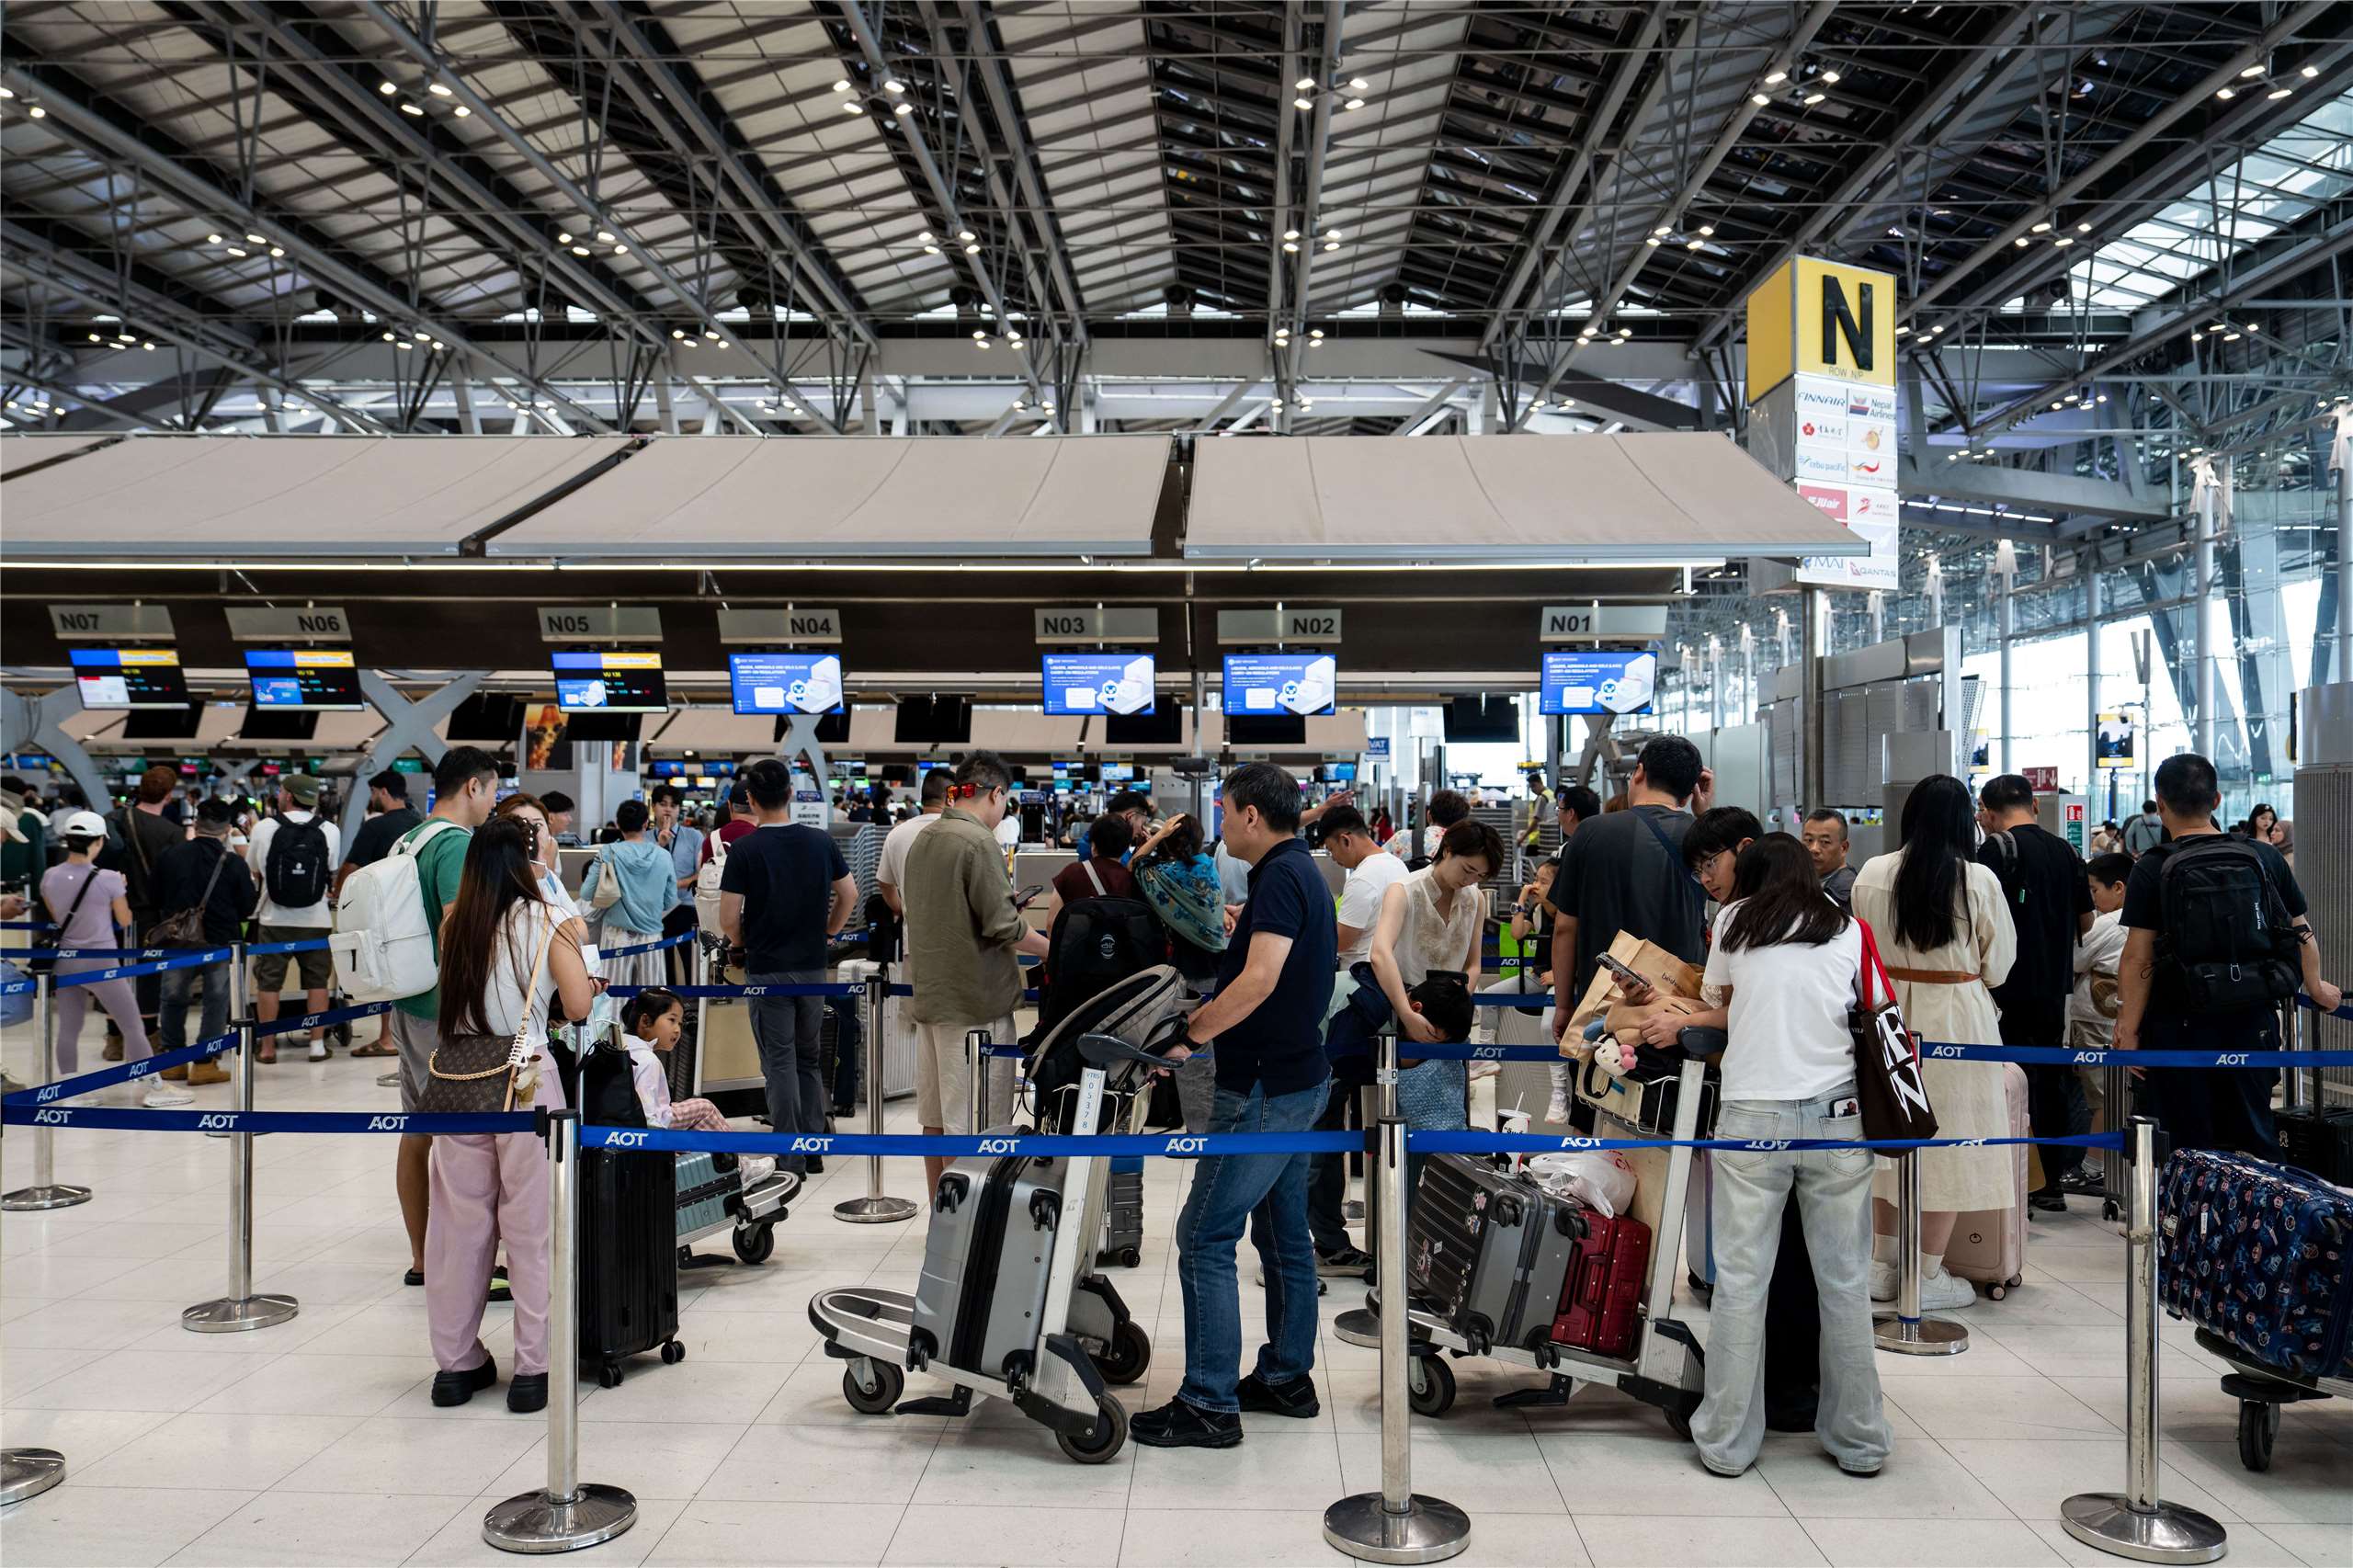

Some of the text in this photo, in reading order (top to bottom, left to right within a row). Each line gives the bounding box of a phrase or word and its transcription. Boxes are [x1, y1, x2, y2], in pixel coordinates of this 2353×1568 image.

[1823, 274, 1873, 371] N
[1828, 367, 1847, 377] ROW
[1798, 392, 1846, 406] FINNAIR
[1870, 397, 1893, 410] Nepal
[1870, 408, 1897, 420] Airlines
[1859, 567, 1896, 577] QANTAS
[59, 613, 99, 630] N07
[298, 615, 340, 632] N06
[547, 615, 589, 632] N05
[790, 618, 832, 634] N04
[1043, 617, 1086, 633] N03
[1293, 618, 1335, 634] N02
[1550, 615, 1591, 632] N01
[57, 949, 78, 958] AOT
[104, 970, 118, 979] AOT
[5, 983, 25, 993] AOT
[743, 986, 767, 995] AOT
[847, 984, 866, 994] AO
[301, 1015, 321, 1028] AOT
[206, 1039, 224, 1054] AOT
[1472, 1047, 1506, 1058] AOT
[1931, 1045, 1965, 1058] AOT
[2074, 1051, 2107, 1063] AOT
[2215, 1053, 2249, 1065] AOT
[129, 1061, 150, 1077] AOT
[37, 1085, 62, 1102] AOT
[34, 1109, 73, 1124] AOT
[198, 1114, 239, 1129] AOT
[368, 1115, 409, 1131] AOT
[605, 1131, 649, 1147] AOT
[790, 1137, 834, 1152] AOT
[977, 1139, 1021, 1153] AOT
[1165, 1137, 1209, 1153] AOT
[1561, 1137, 1604, 1148] AOT
